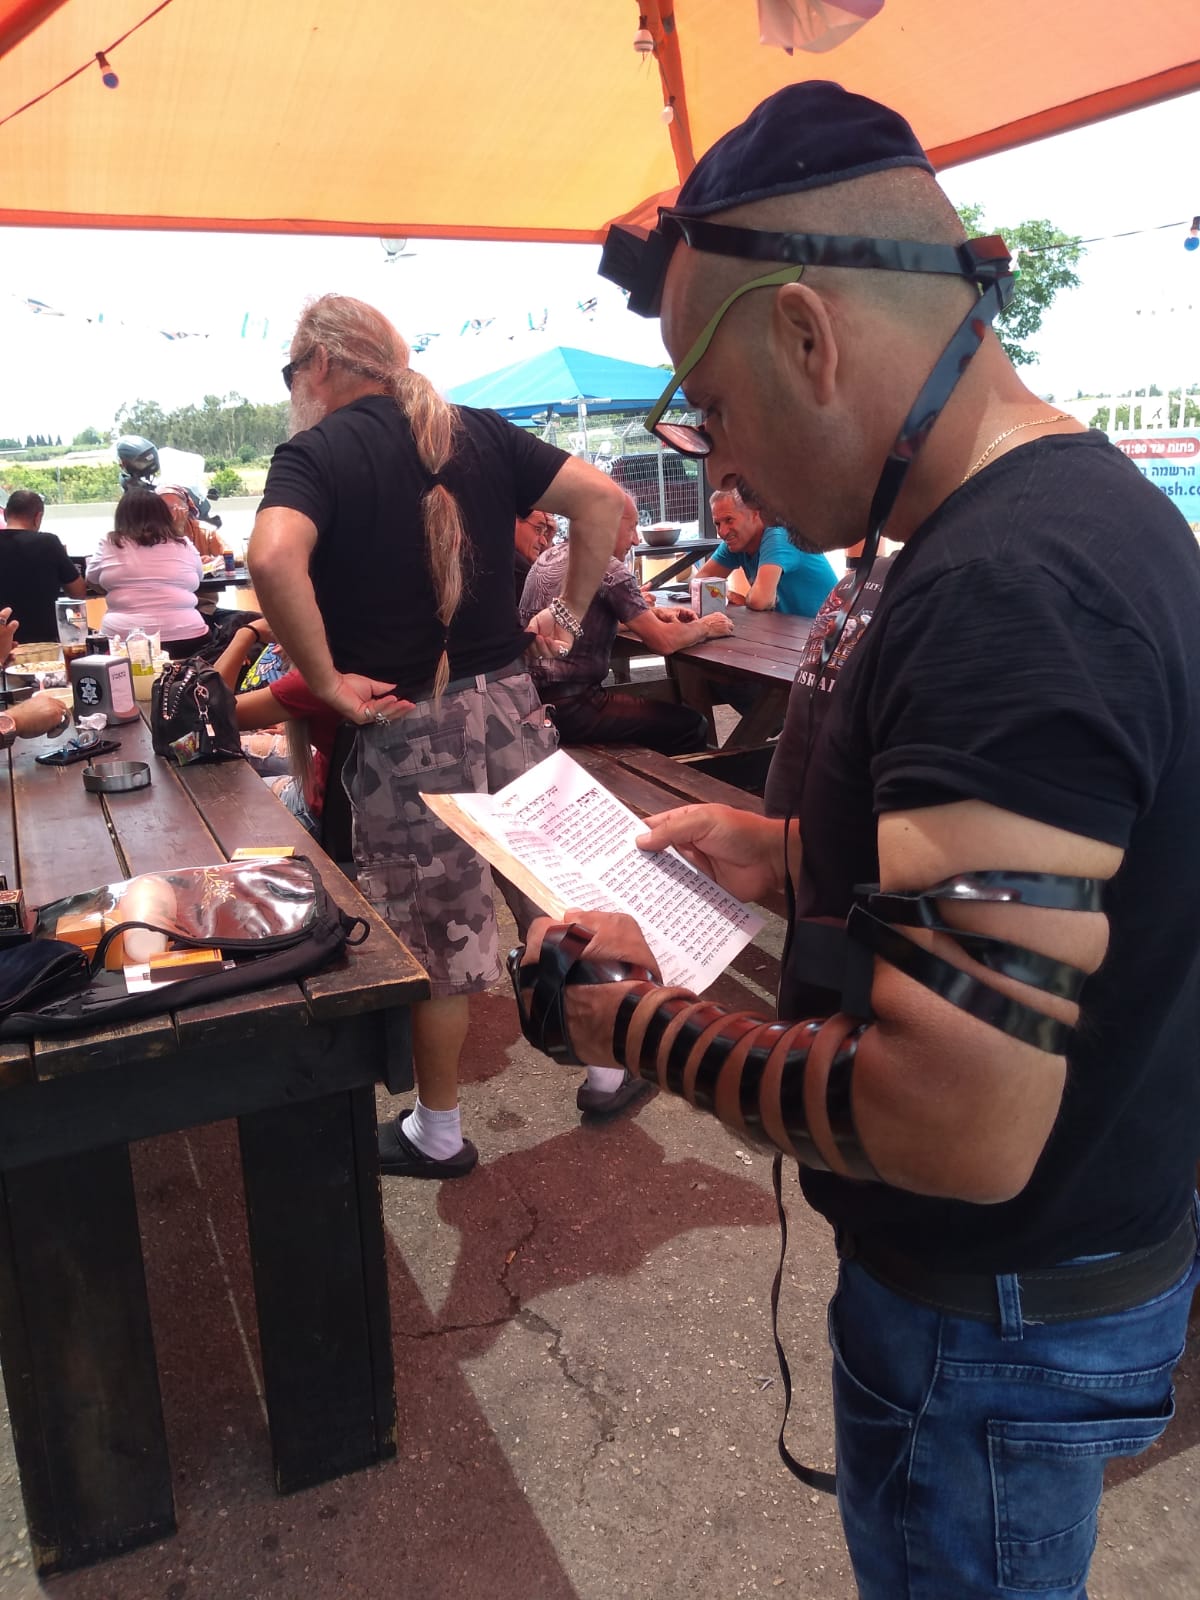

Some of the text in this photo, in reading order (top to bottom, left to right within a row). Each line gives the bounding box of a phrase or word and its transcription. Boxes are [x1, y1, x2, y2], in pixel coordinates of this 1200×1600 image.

[1150, 443, 1165, 454] עד
[1167, 442, 1195, 453] פתוח
[1151, 466, 1196, 476] הרשמה
